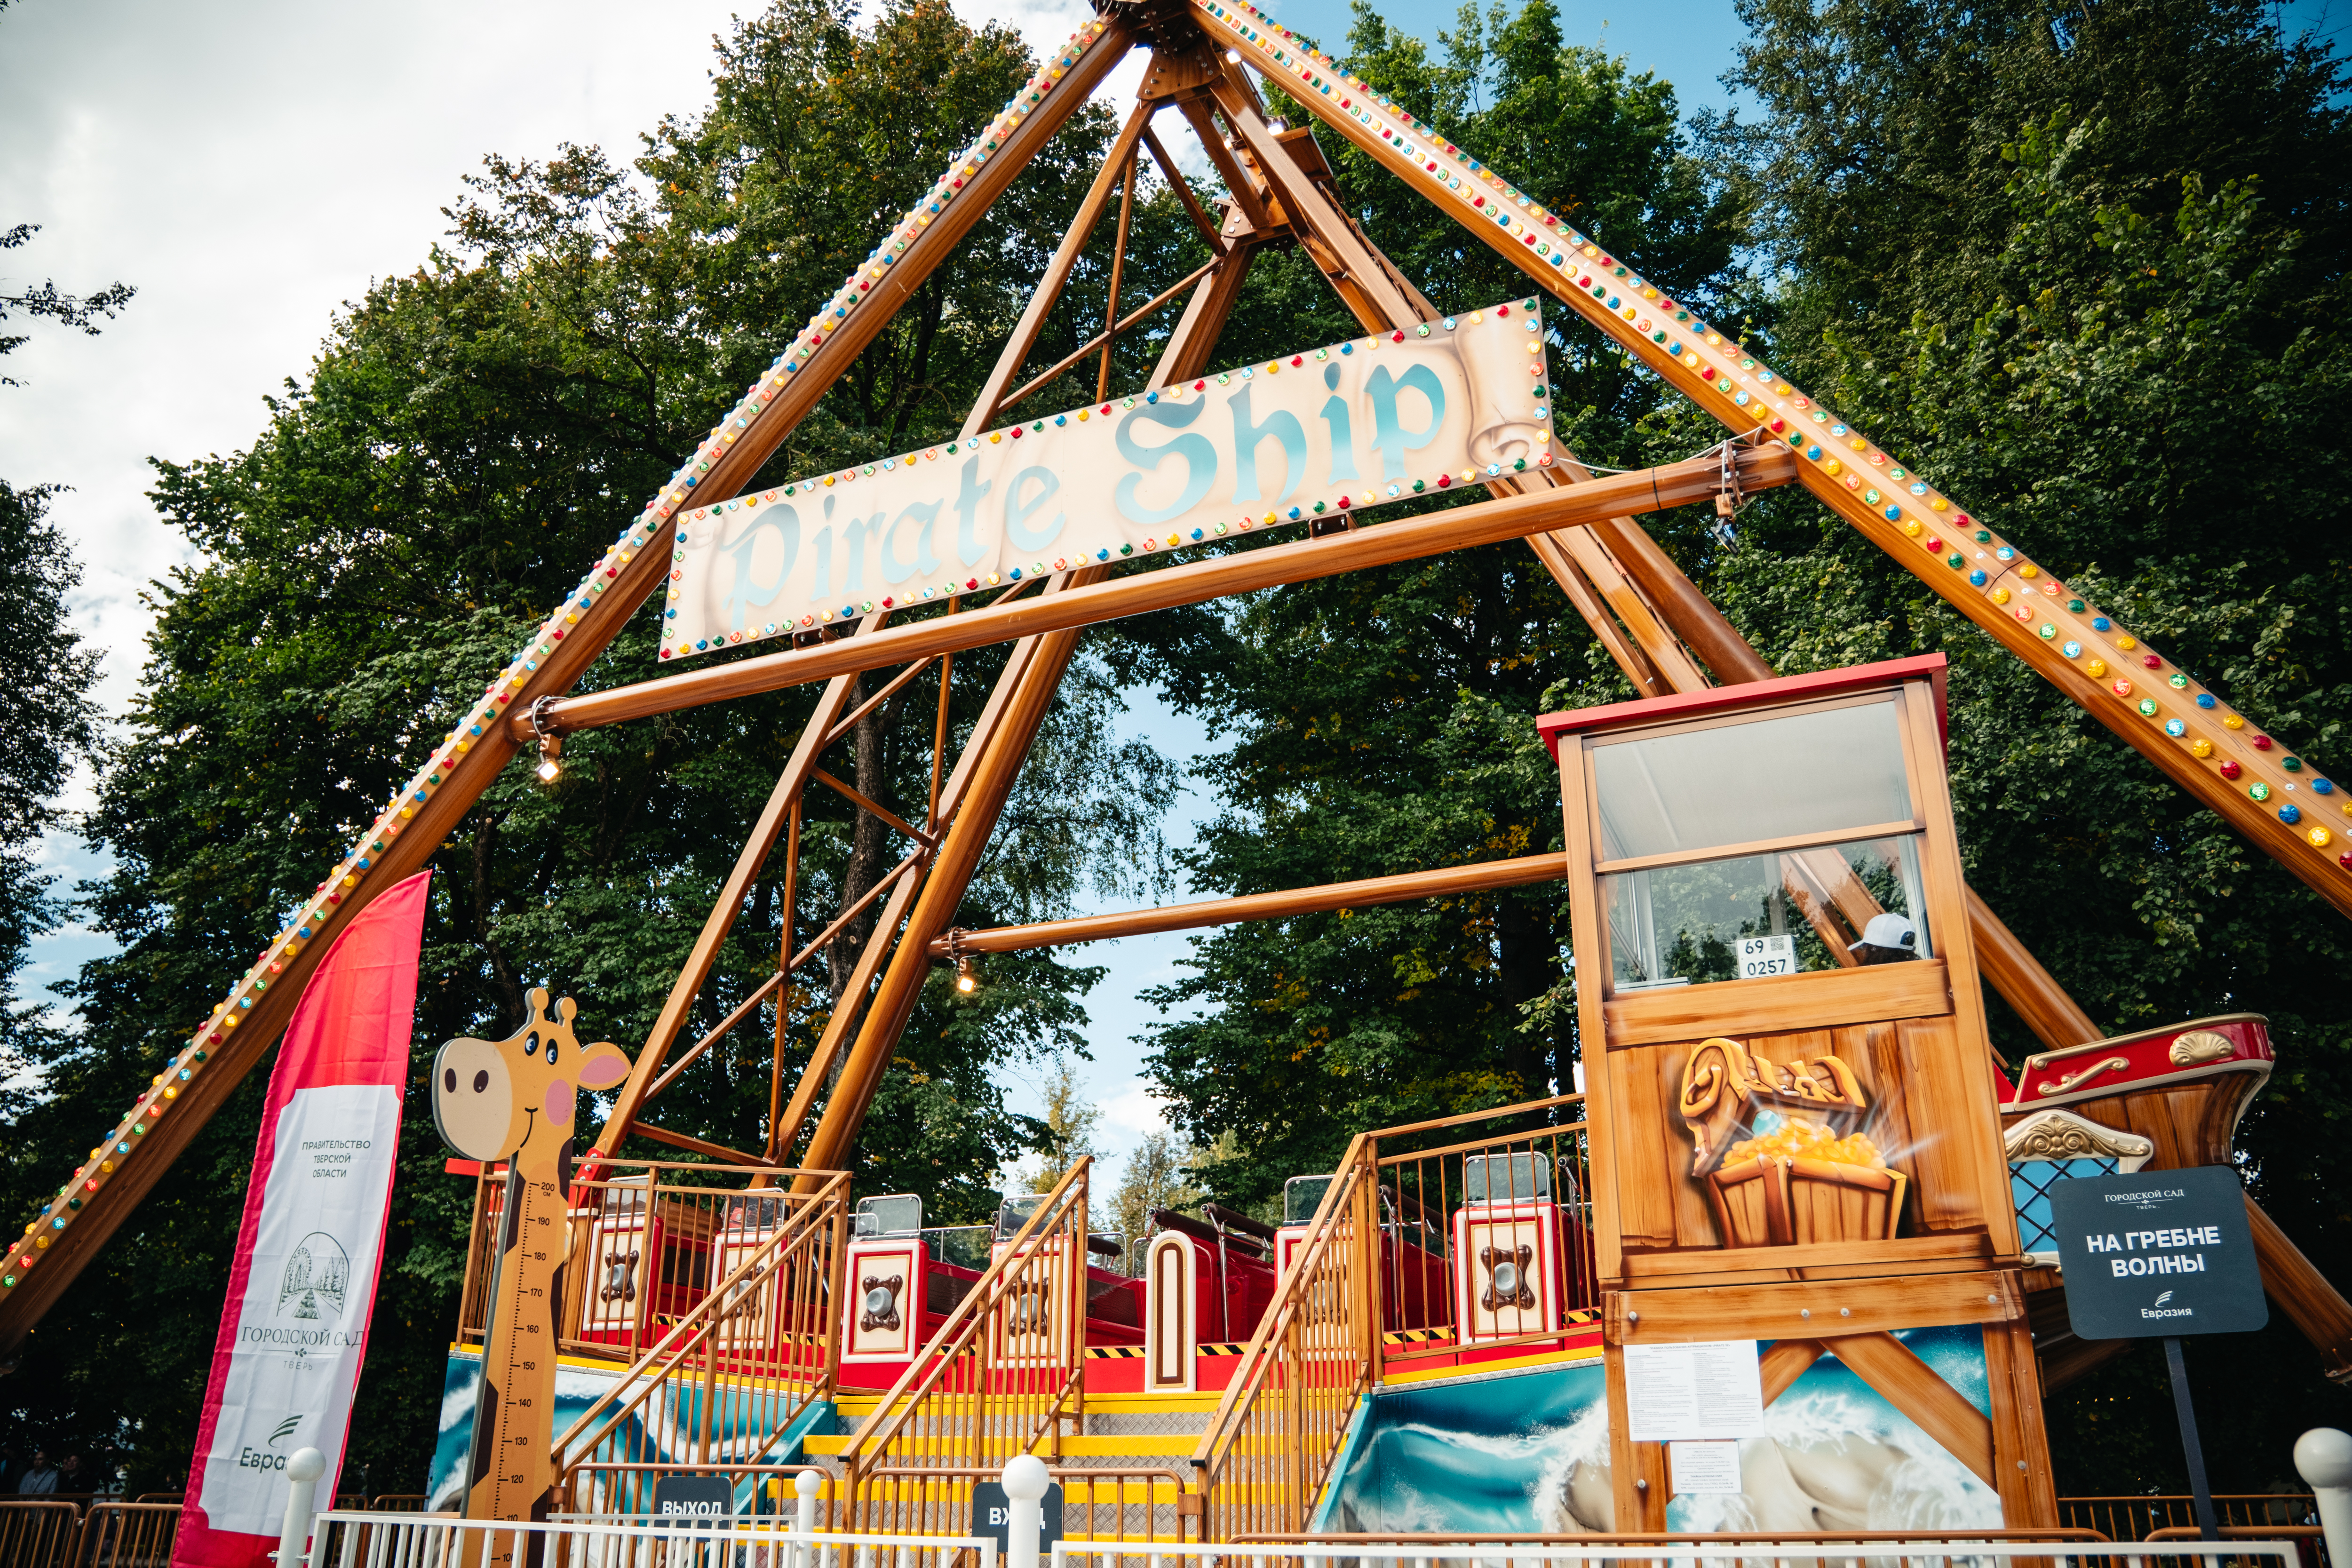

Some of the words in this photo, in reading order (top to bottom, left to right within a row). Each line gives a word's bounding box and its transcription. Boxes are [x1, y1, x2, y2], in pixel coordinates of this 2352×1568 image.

[719, 454, 1066, 631] Pirate
[1115, 362, 1445, 524] Ship
[1745, 940, 1764, 954] 69
[1748, 959, 1786, 975] 0257
[302, 1140, 371, 1150] ПРАВИТЕЛЬСТВО
[314, 1153, 351, 1163] ТВЕРСКОЙ
[313, 1169, 347, 1178] ОБЛАСТИ
[541, 1182, 555, 1192] 200
[2105, 1190, 2161, 1202] ГОРОДСКОЙ
[538, 1217, 550, 1226] 190
[2086, 1234, 2122, 1253] НА
[2125, 1226, 2221, 1250] ГРЕБНЕ
[534, 1252, 546, 1261] 180
[2111, 1254, 2205, 1277] ВОЛНЫ
[530, 1288, 542, 1297] 170
[2141, 1308, 2192, 1319] Евразия
[526, 1324, 539, 1333] 160
[241, 1327, 330, 1346] ГОРОДСКОЙ
[334, 1331, 364, 1348] САД
[284, 1361, 312, 1370] ТВЕРЬ
[523, 1361, 535, 1370] 150
[519, 1399, 531, 1407] 140
[515, 1437, 527, 1445] 130
[240, 1447, 291, 1473] Евра
[511, 1475, 524, 1483] 120
[662, 1501, 723, 1521] ВЫХОД
[989, 1507, 1046, 1529] ВХ
